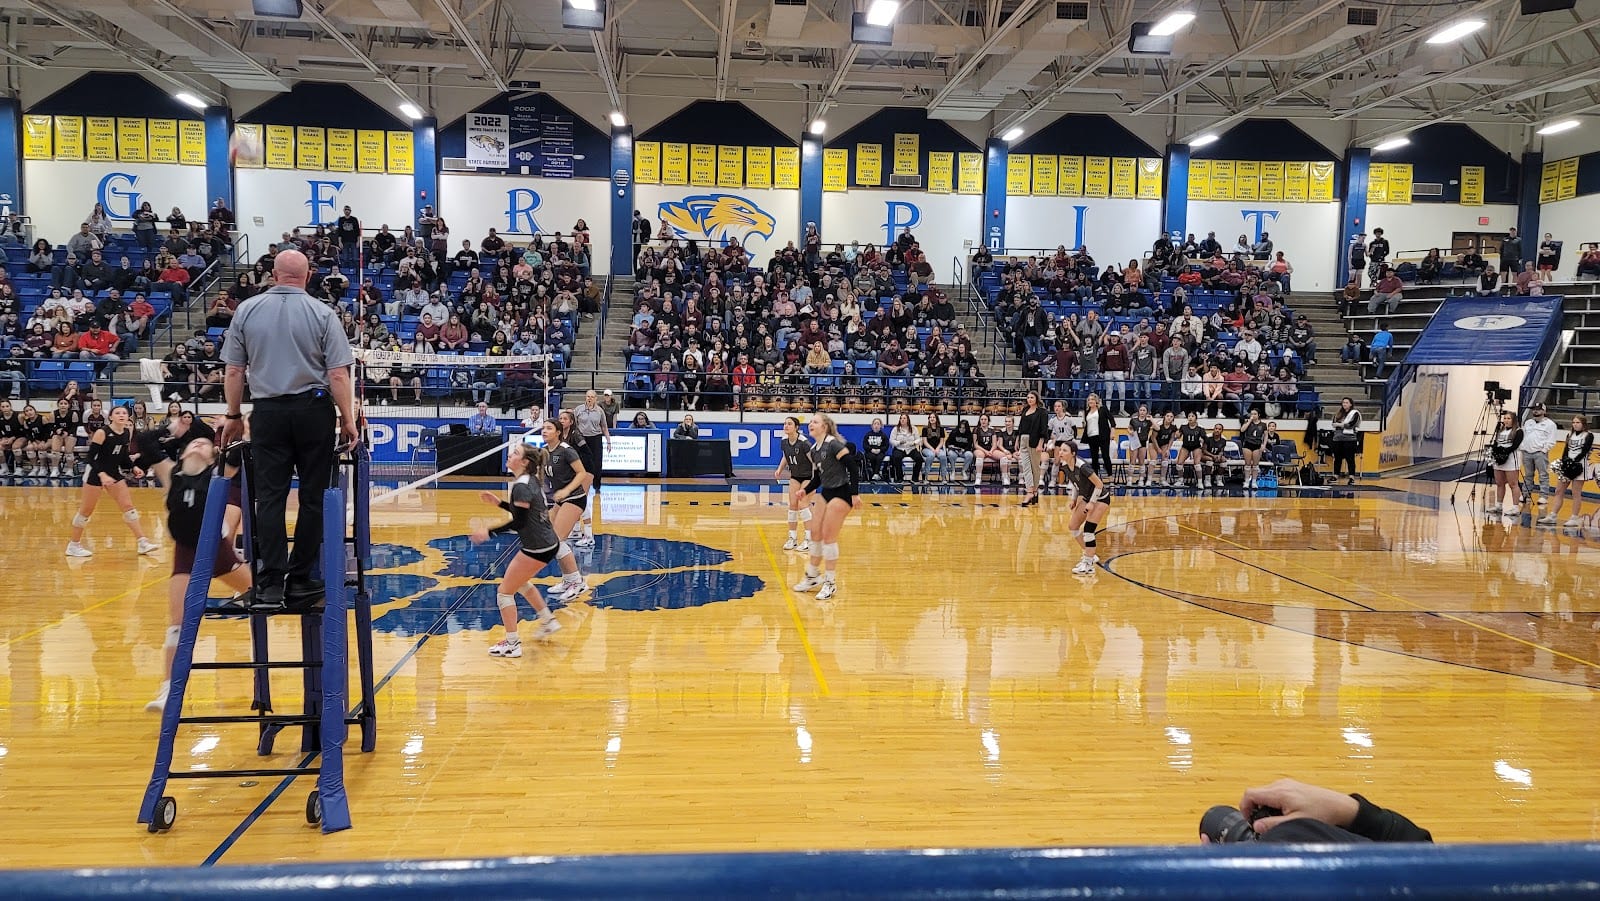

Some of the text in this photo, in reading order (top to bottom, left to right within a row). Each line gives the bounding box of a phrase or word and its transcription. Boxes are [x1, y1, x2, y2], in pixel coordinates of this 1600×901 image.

[474, 116, 501, 127] 2022
[97, 172, 142, 220] G
[504, 188, 547, 234] R
[881, 200, 923, 248] P
[1072, 205, 1090, 250] I
[1240, 209, 1281, 246] T
[982, 436, 990, 444] 15
[788, 455, 798, 464] 14
[184, 489, 194, 508] 4
